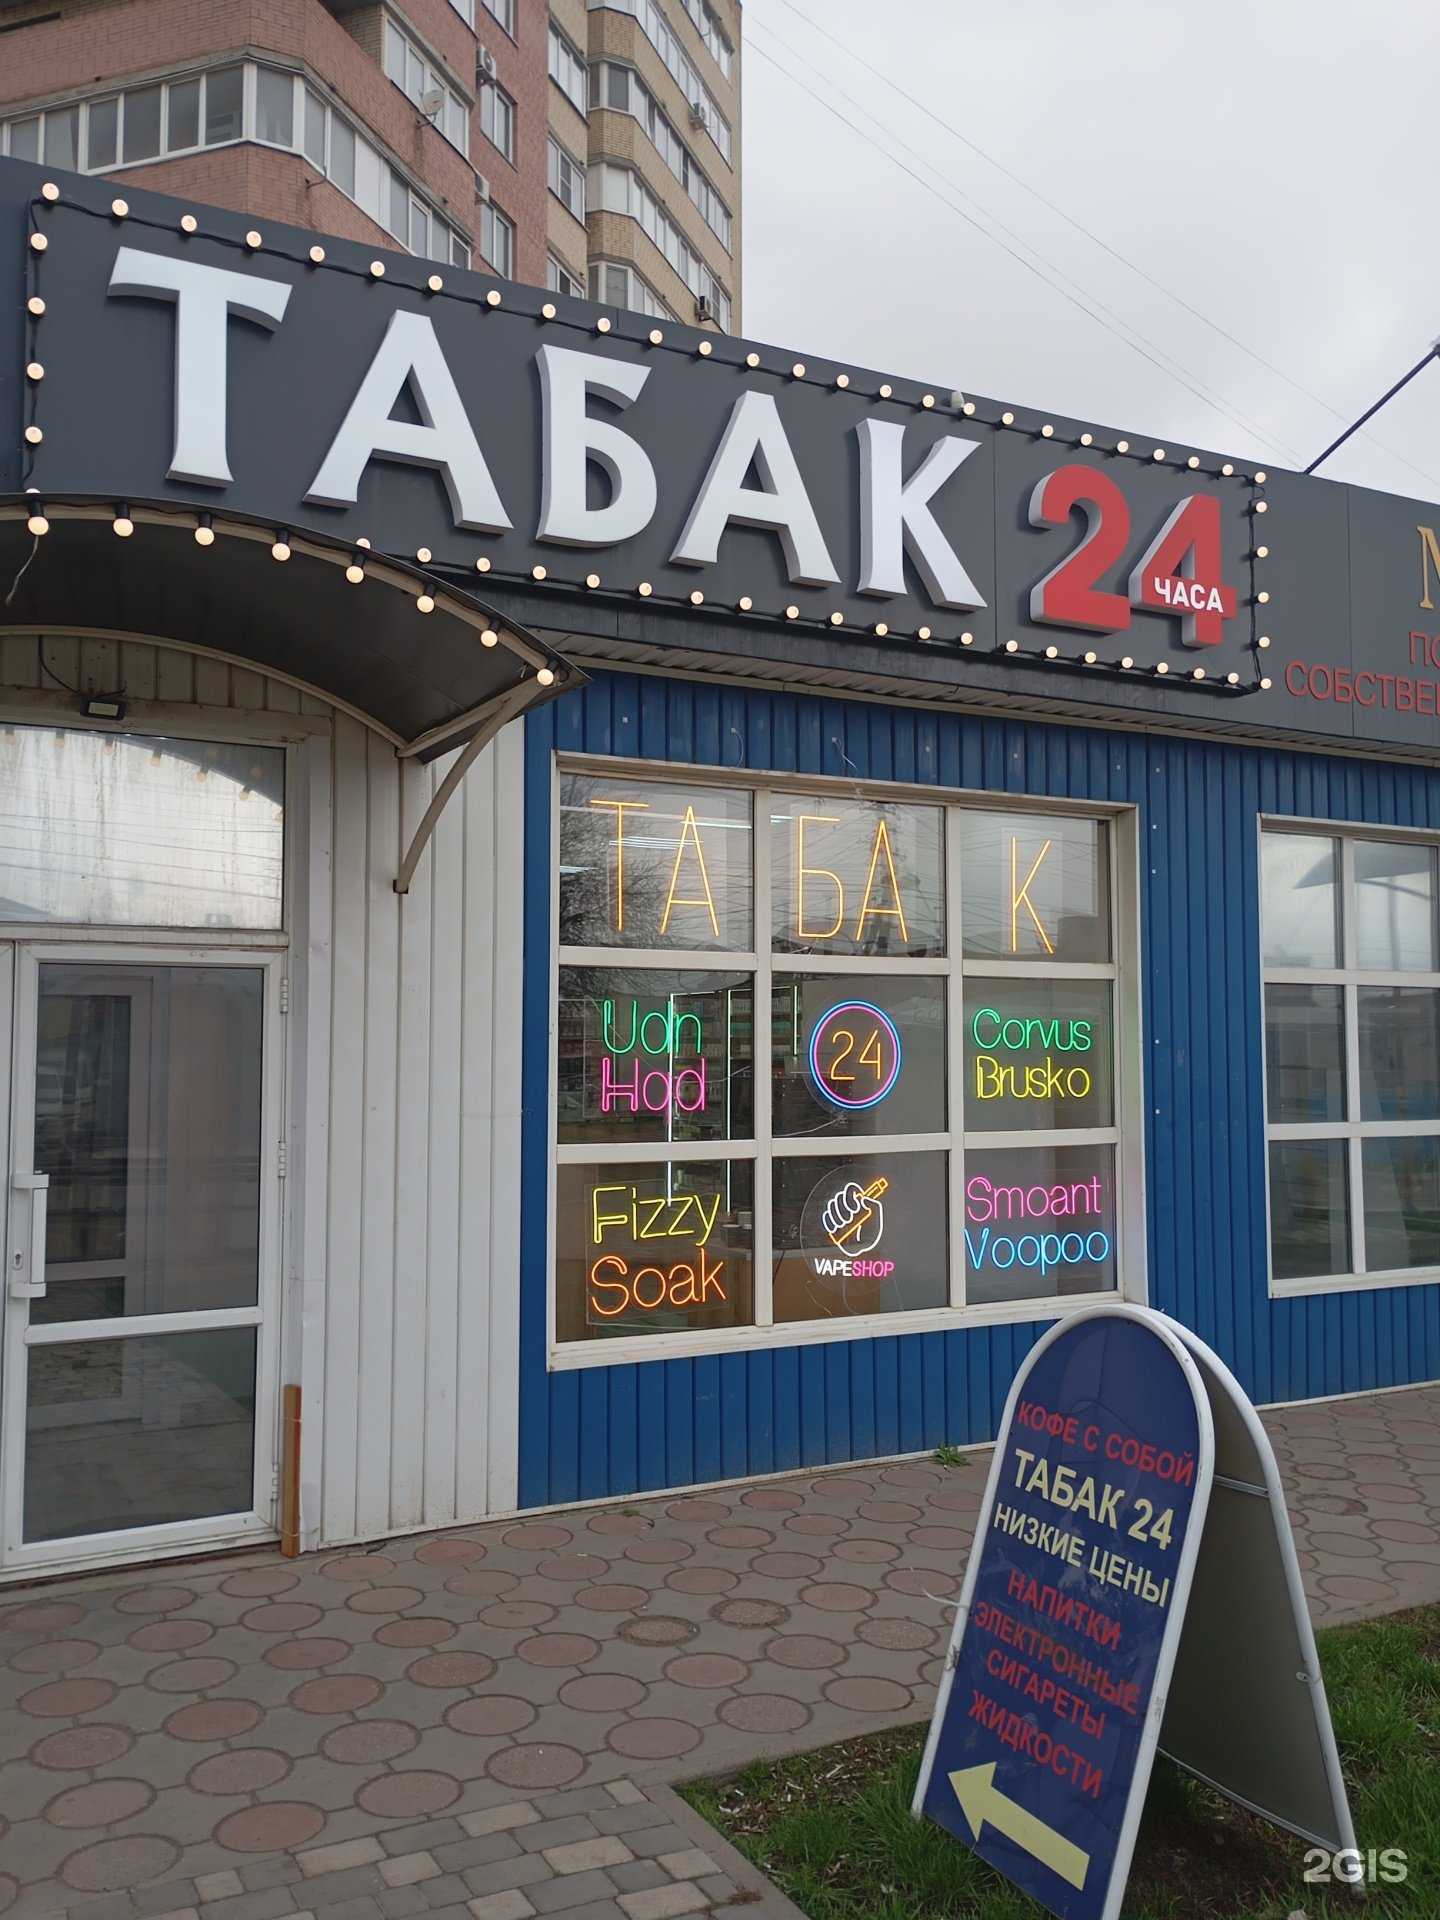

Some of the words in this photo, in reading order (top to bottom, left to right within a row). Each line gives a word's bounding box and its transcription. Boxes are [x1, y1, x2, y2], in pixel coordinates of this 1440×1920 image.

[107, 246, 987, 613] ТАБАК
[1028, 464, 1237, 649] 24
[1154, 576, 1224, 613] ЧАСА
[1284, 660, 1440, 718] СОБСТВЕ
[589, 799, 1055, 955] ТАБАК
[829, 1029, 882, 1081] 24
[973, 1007, 1091, 1051] Corvus
[975, 1055, 1091, 1099] Brusko
[592, 1186, 721, 1247] Fizzy
[967, 1175, 1103, 1222] Smoant
[591, 1247, 727, 1316] Soak
[963, 1227, 1109, 1276] Voopoo
[1017, 1401, 1079, 1449] КОФЕ
[1083, 1427, 1100, 1451] С
[1105, 1432, 1196, 1488] СОБОЙ
[1015, 1448, 1126, 1530] ТАБАК
[1128, 1498, 1176, 1551] 24
[993, 1502, 1087, 1568] НИЗКИЕ
[1089, 1544, 1170, 1608] ЦЕНЫ
[1007, 1568, 1122, 1651] НАПИТКИ
[975, 1601, 1142, 1716] ЭЛЕКТРОННЫЕ
[986, 1649, 1107, 1740] СИГАРЕТЫ
[967, 1689, 1104, 1799] ЖИДКОСТИ
